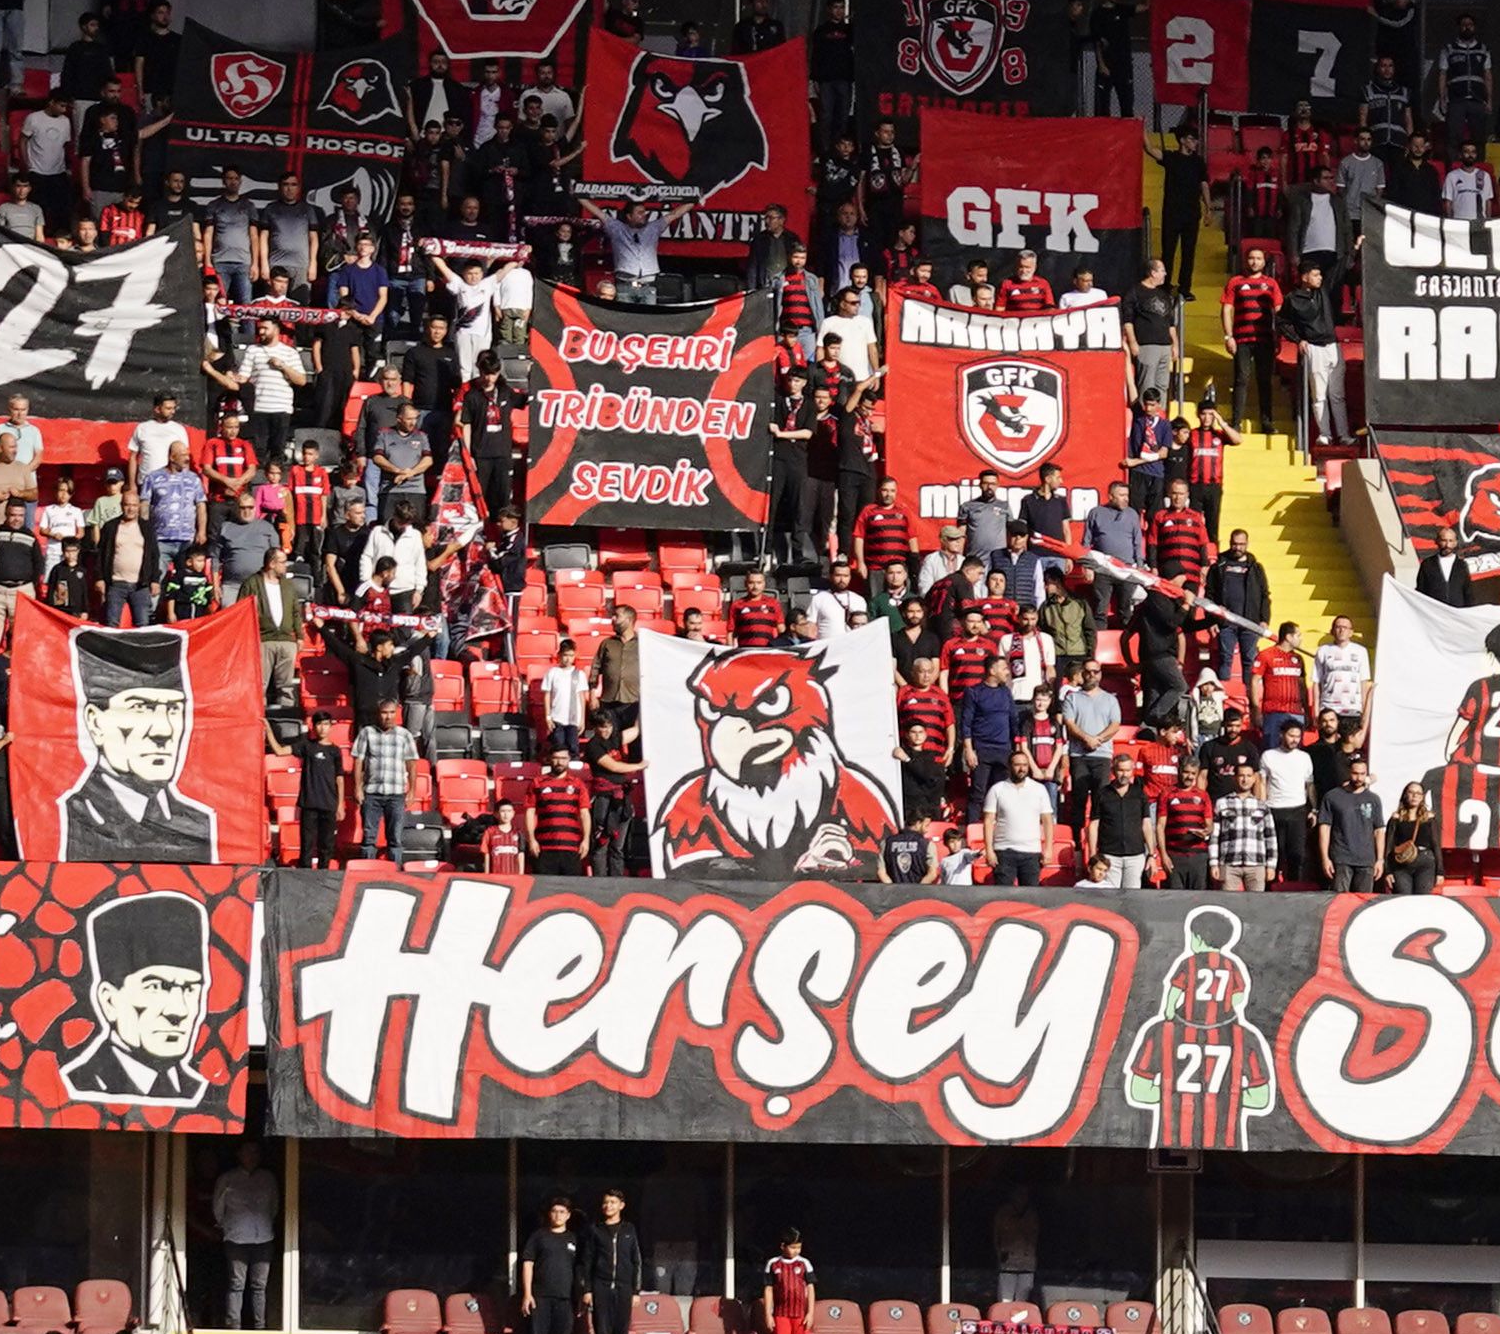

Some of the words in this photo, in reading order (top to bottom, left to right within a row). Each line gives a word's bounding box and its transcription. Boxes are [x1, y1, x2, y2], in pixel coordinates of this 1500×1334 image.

[944, 0, 980, 15] GFK
[184, 128, 291, 149] ULTRAS
[946, 181, 1099, 253] GFK
[559, 328, 621, 362] BU
[622, 326, 736, 373] ŞEHRİ
[902, 304, 1121, 354] ARMAYA
[986, 367, 1037, 388] GFK
[539, 386, 755, 440] TRİBÜNDEN
[570, 461, 714, 507] SEVDİK
[297, 881, 1117, 1139] Herşey
